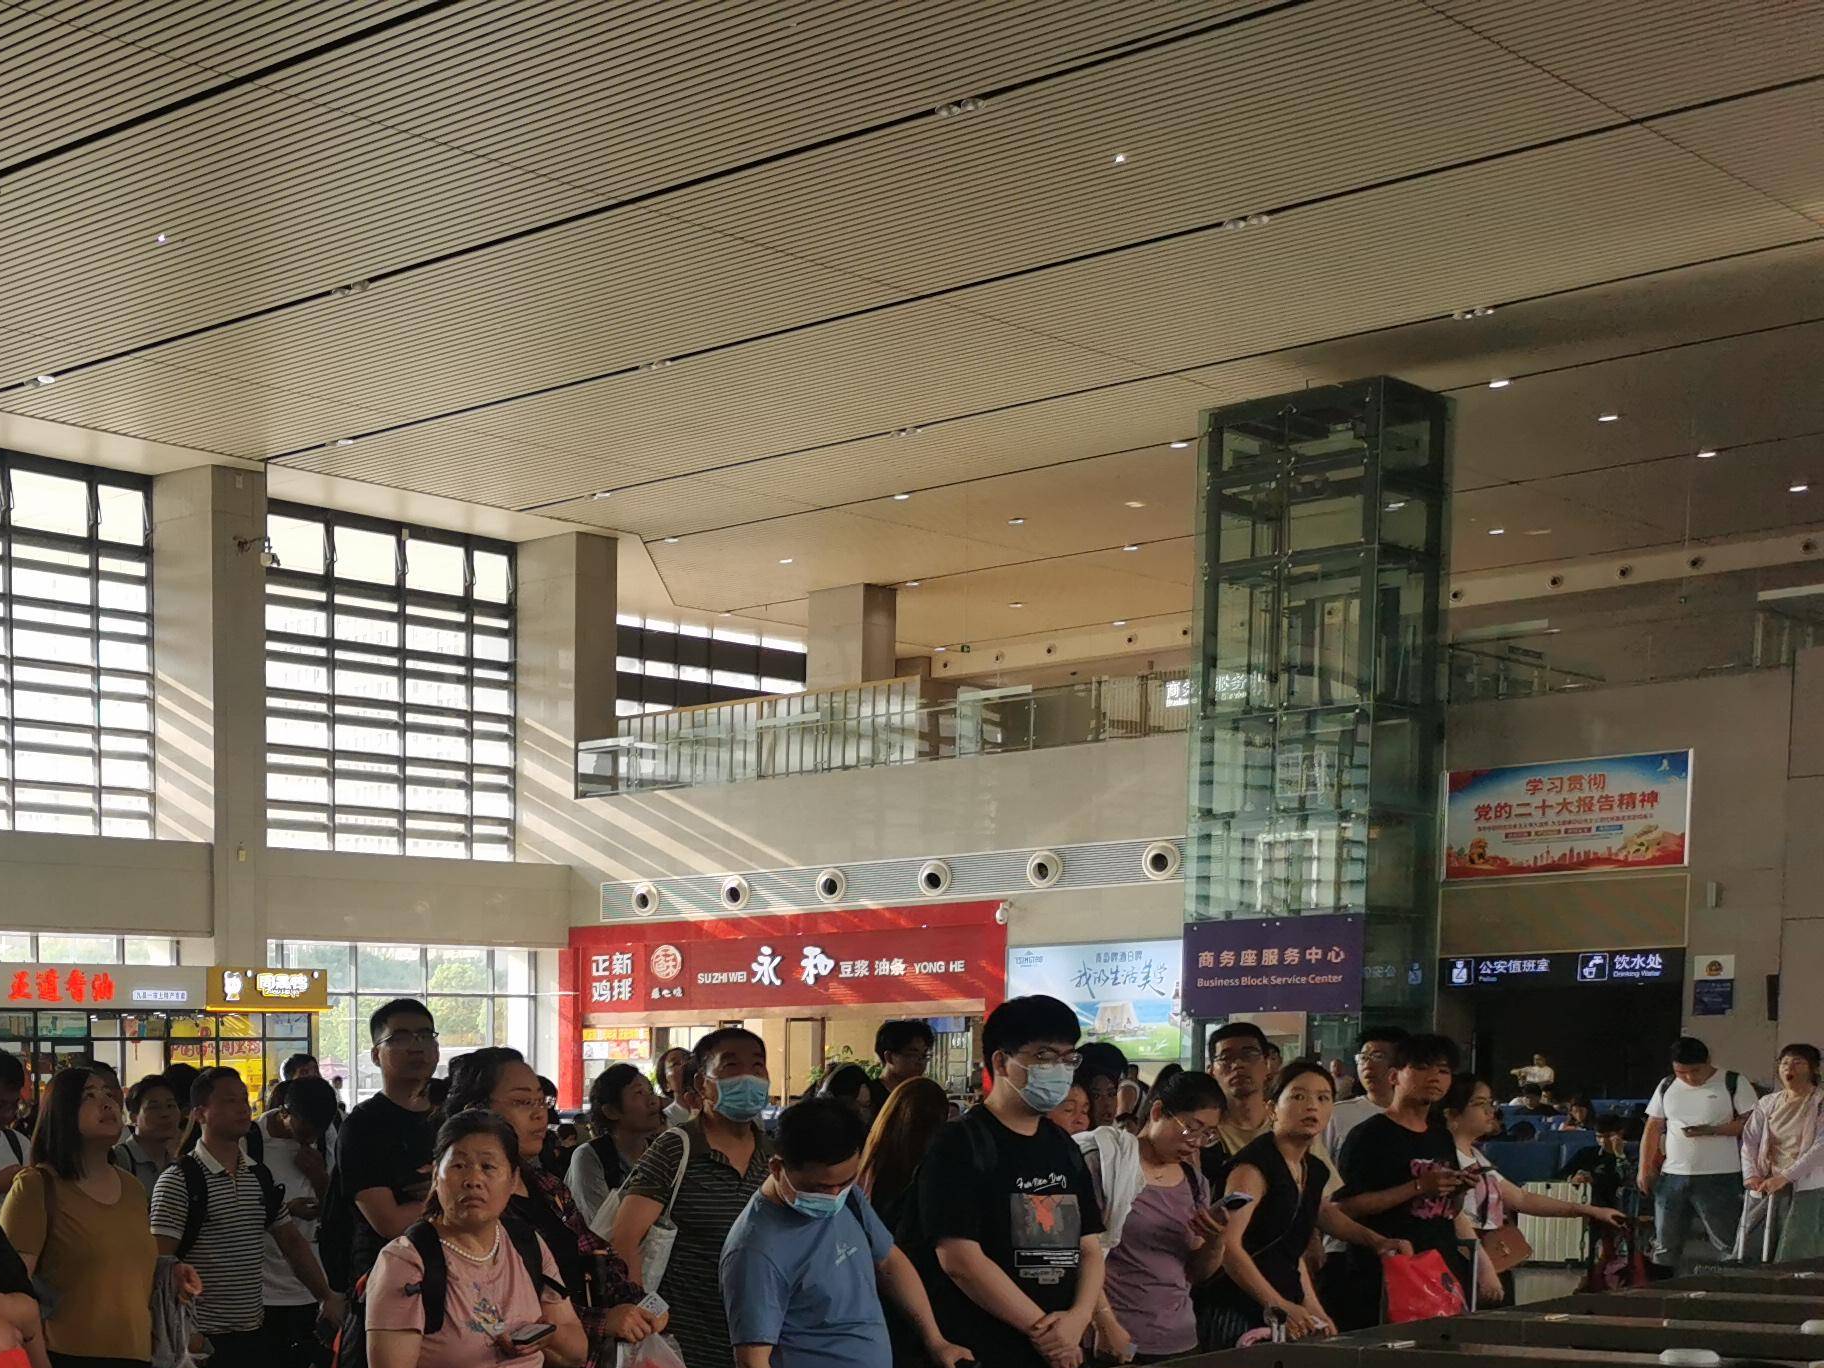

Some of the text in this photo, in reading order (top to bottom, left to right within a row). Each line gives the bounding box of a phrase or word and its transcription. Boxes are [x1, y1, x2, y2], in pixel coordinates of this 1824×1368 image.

[1526, 773, 1607, 796] 学习贯彻
[1475, 791, 1660, 821] 党的二十大报告精神
[592, 952, 632, 976] 正新
[913, 960, 965, 974] YONG HE
[1198, 946, 1345, 968] 商务座服务中心
[1479, 958, 1550, 974] 公安值班室
[1614, 954, 1662, 970] 饮水处
[1070, 959, 1168, 999] 我的生活美学
[1197, 974, 1343, 987] Business Block Service Center
[592, 979, 632, 1002] 鸡排
